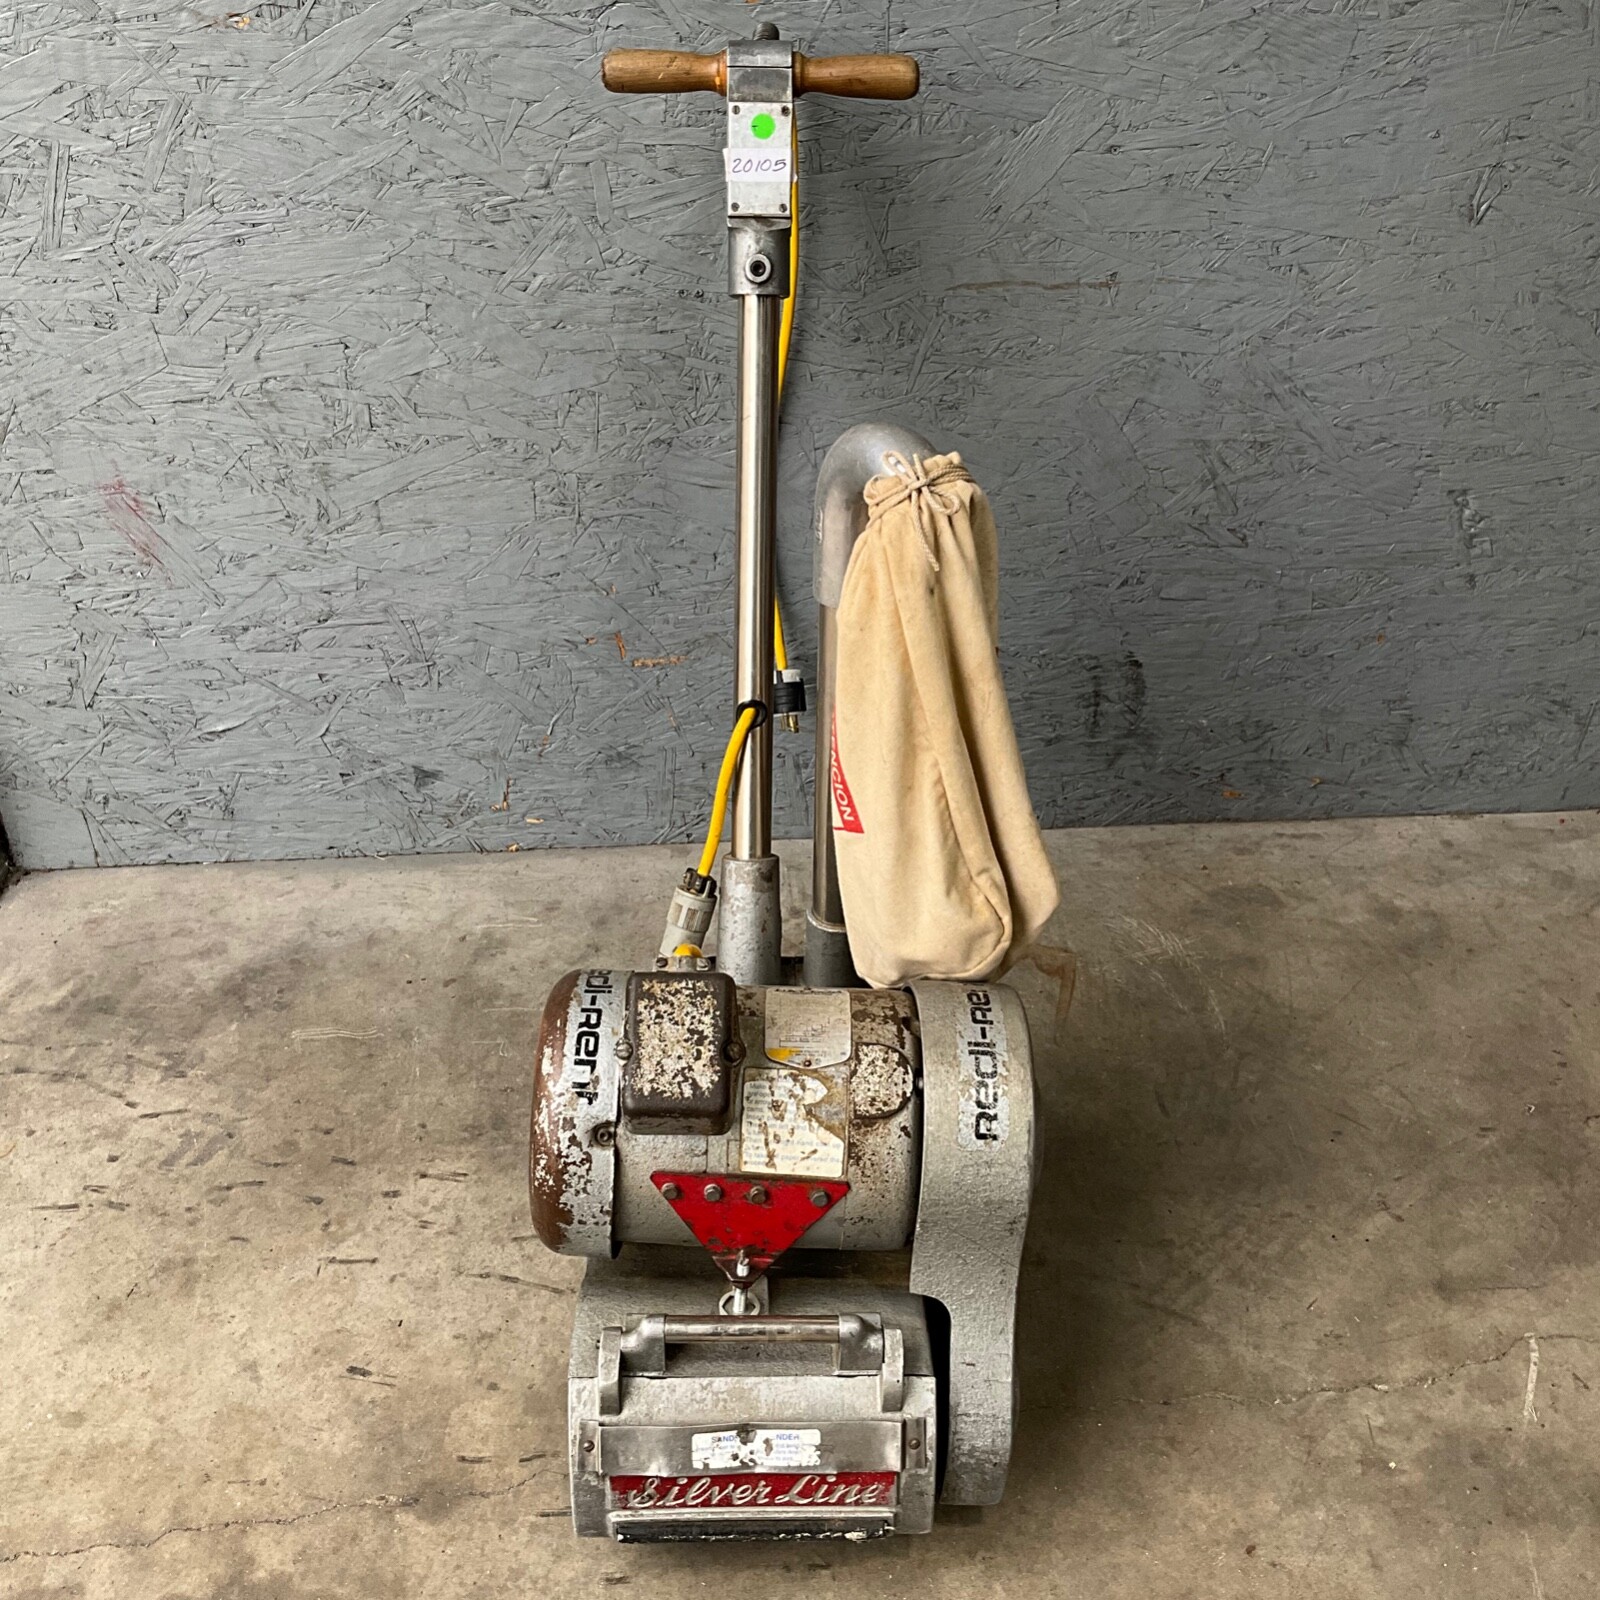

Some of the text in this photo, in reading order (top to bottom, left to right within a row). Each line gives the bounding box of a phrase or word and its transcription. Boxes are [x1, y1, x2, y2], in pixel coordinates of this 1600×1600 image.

[732, 158, 787, 173] 20105
[573, 969, 612, 1105] edi-Rent
[967, 984, 999, 1141] Redi-Re
[629, 1475, 880, 1508] Silver Line
